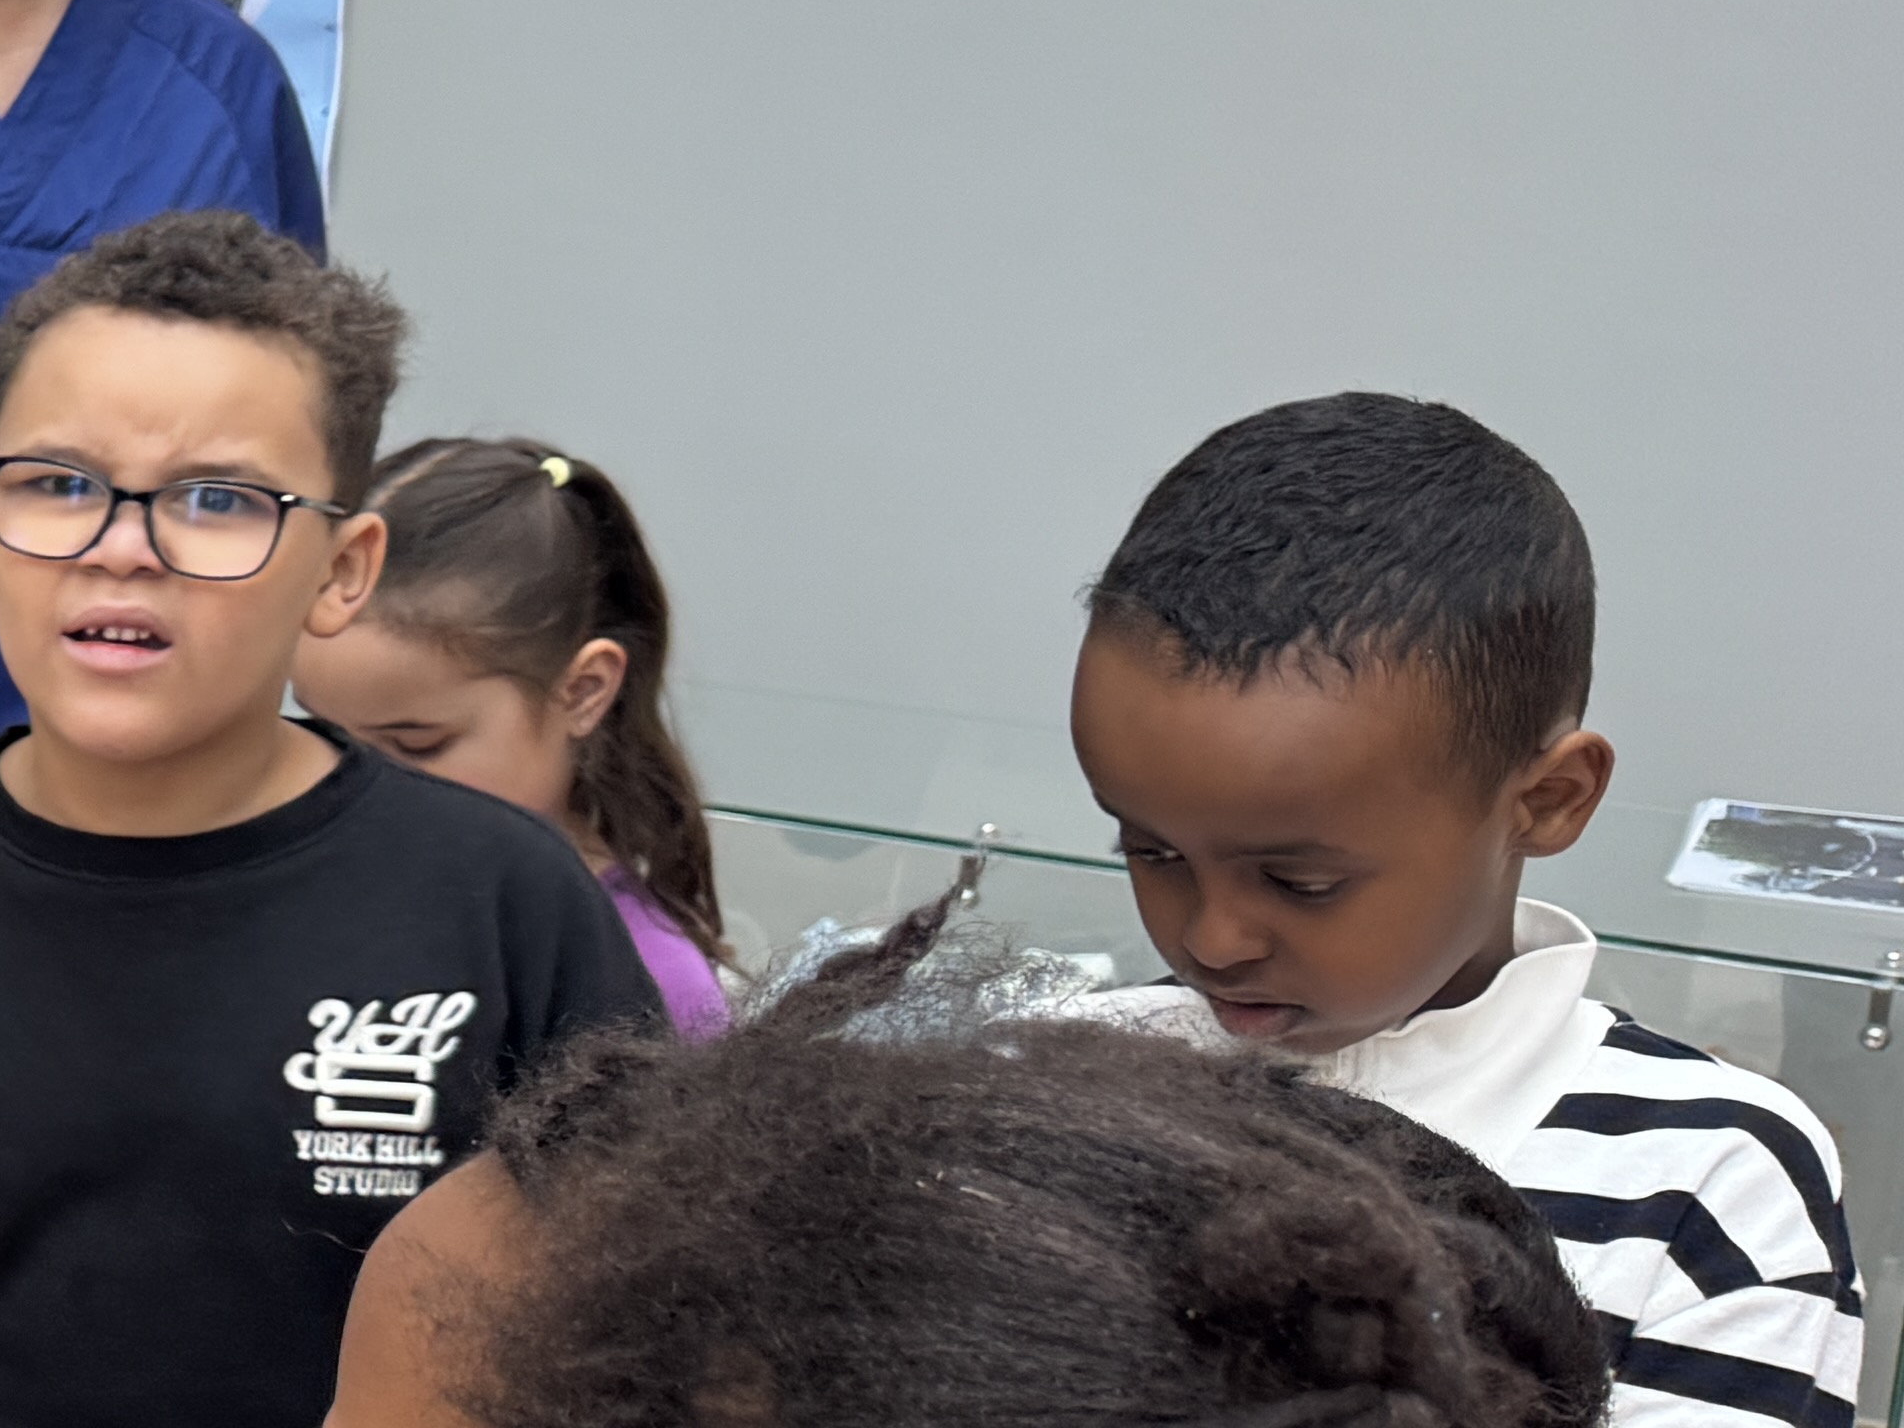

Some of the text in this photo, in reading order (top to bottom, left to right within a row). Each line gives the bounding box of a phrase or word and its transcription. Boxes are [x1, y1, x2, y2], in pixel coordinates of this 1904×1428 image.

[292, 1129, 445, 1166] YORK HILL
[313, 1164, 422, 1197] STUDIO
